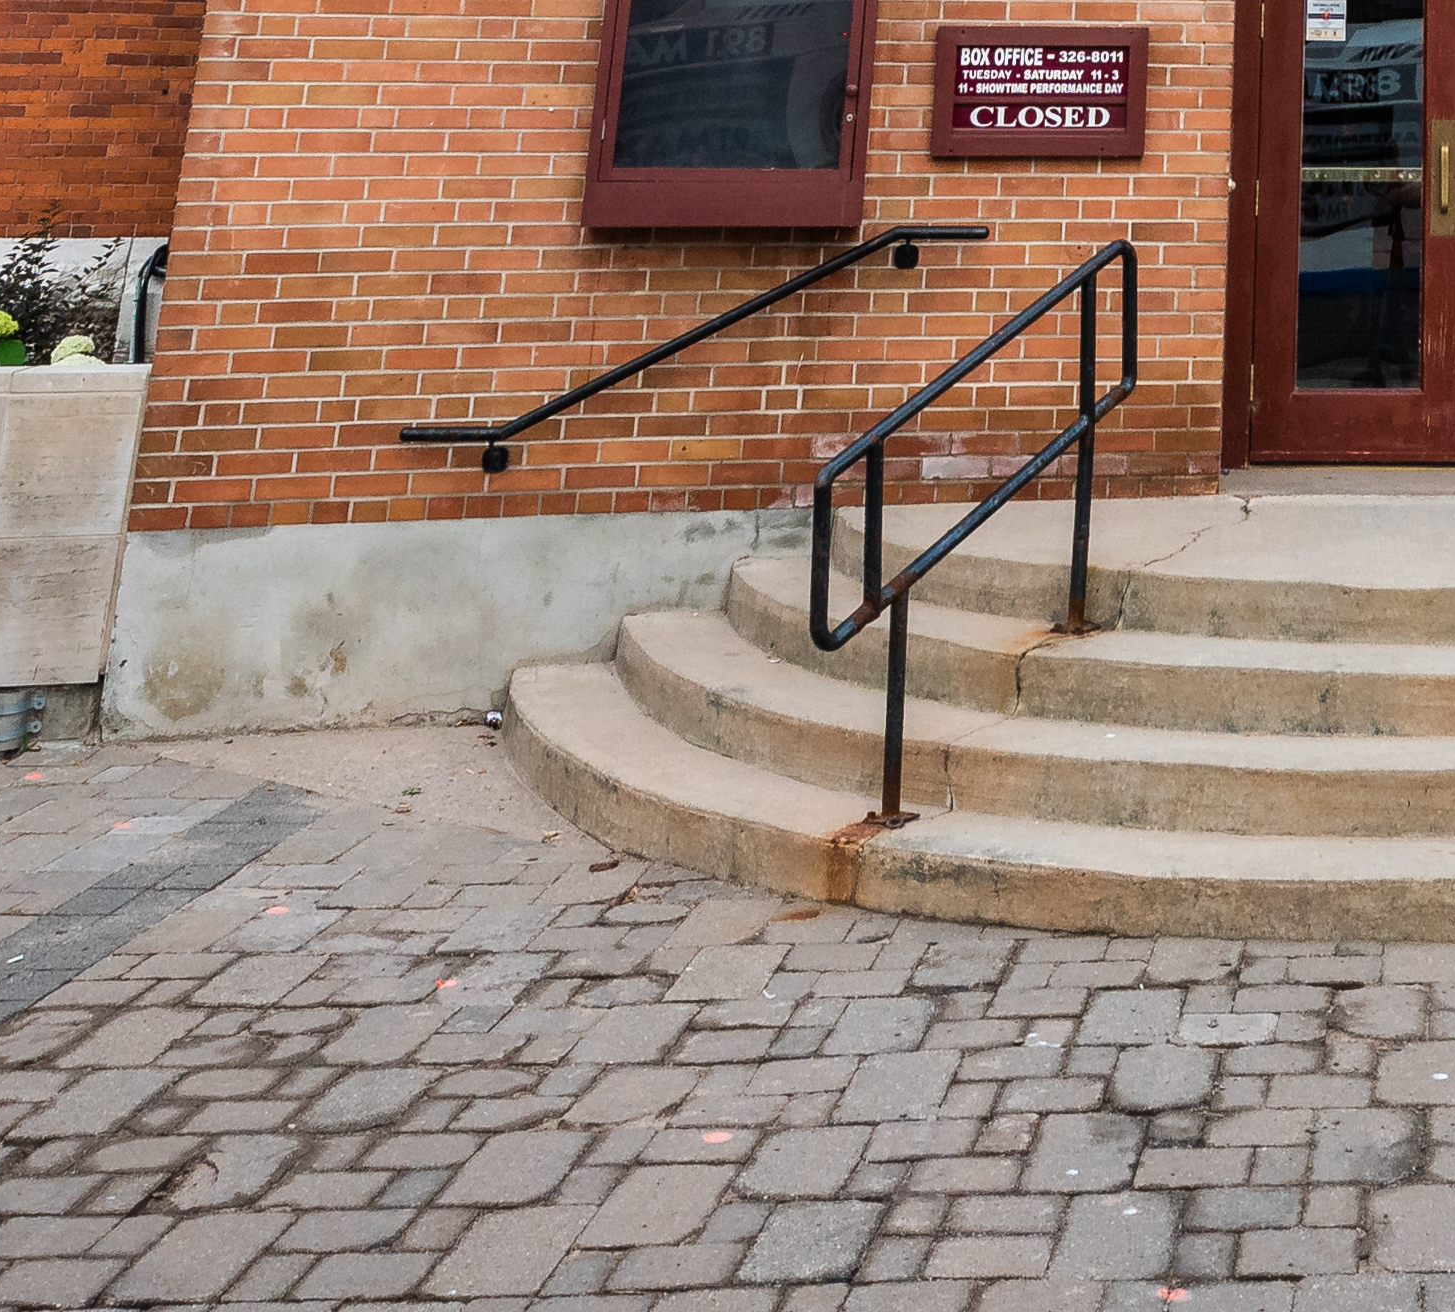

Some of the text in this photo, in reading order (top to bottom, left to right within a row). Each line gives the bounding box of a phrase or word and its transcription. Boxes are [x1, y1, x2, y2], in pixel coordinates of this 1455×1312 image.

[960, 47, 1124, 66] BOX OFFICE 326-8011
[963, 70, 1084, 80] TUESDAY SATURDAY
[976, 83, 1123, 94] SHOWTIME PERFORMANCE DAY
[970, 106, 1110, 127] CLOSED
